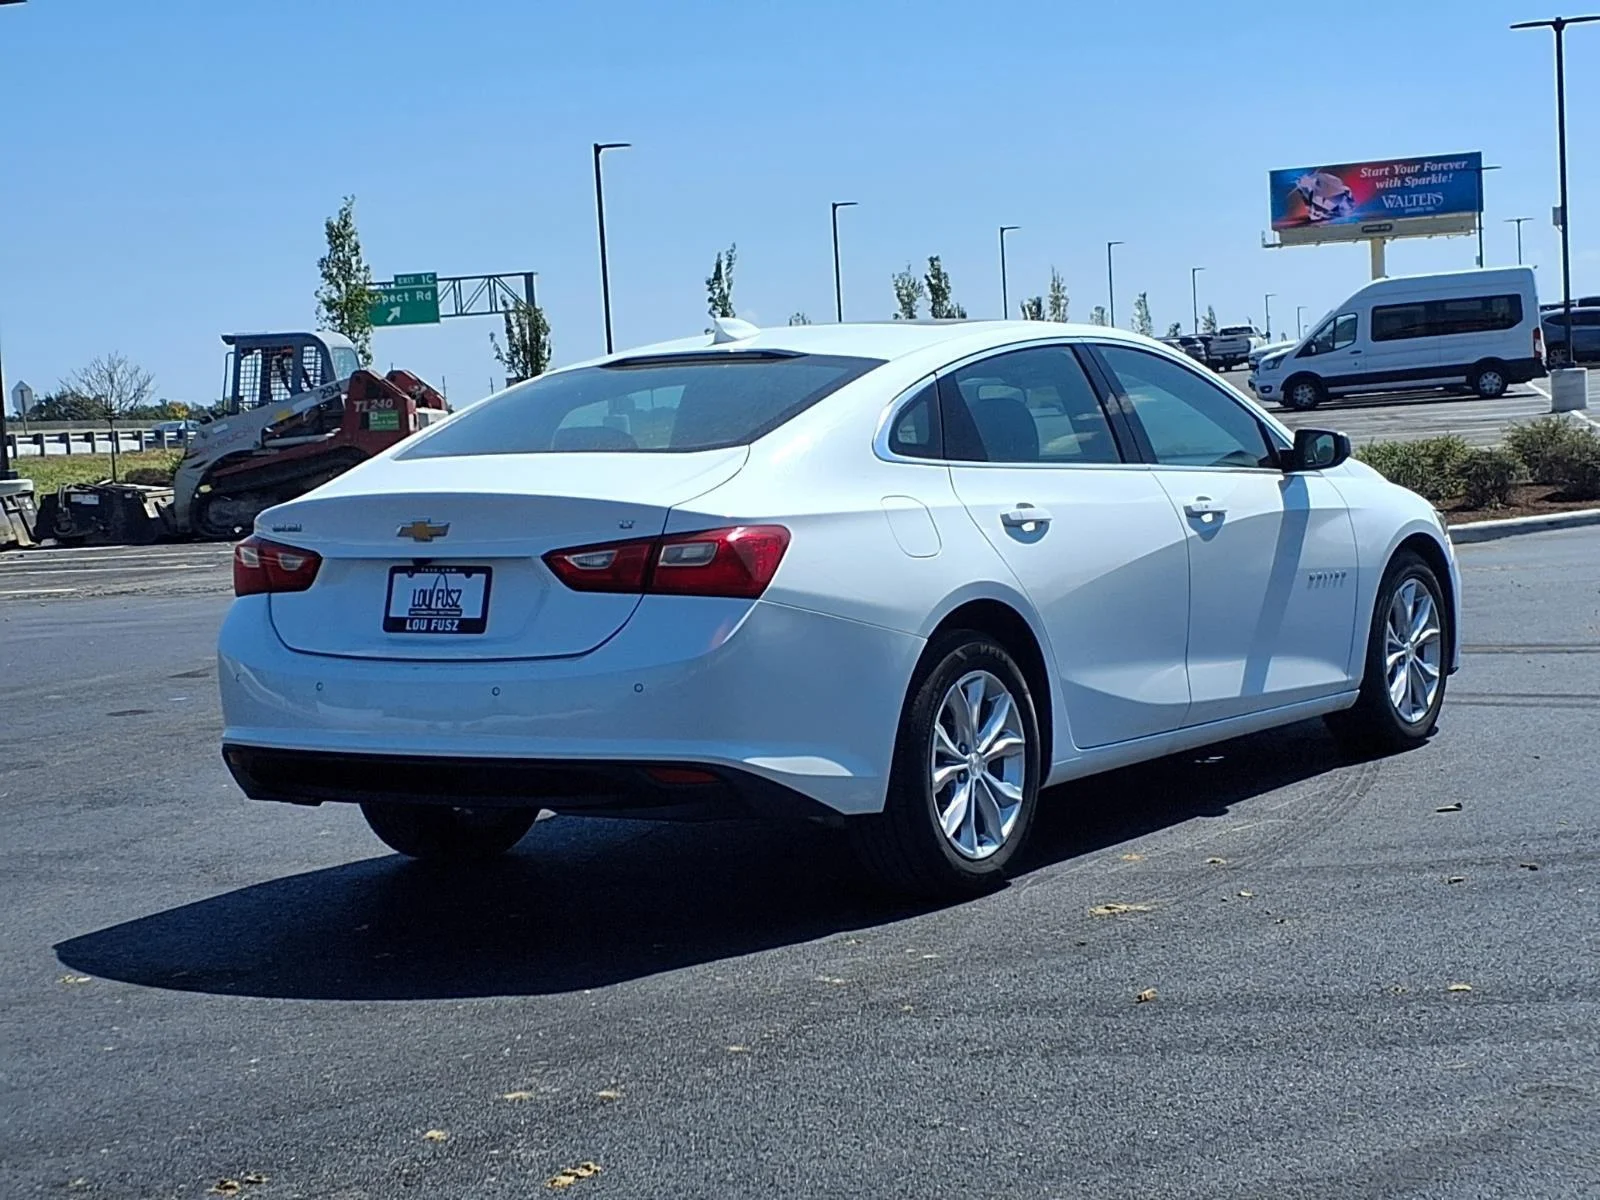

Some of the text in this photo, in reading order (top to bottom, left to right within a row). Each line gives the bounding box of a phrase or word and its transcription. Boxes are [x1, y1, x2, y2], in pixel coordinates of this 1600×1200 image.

[1360, 160, 1468, 178] Start Your Forever
[1375, 173, 1453, 189] with Sparkle!
[1381, 192, 1444, 209] WALTERS
[421, 274, 434, 284] 1C
[416, 290, 432, 302] Rd
[412, 588, 462, 608] LOU FUSZ
[405, 619, 460, 631] LOU FUSZ
